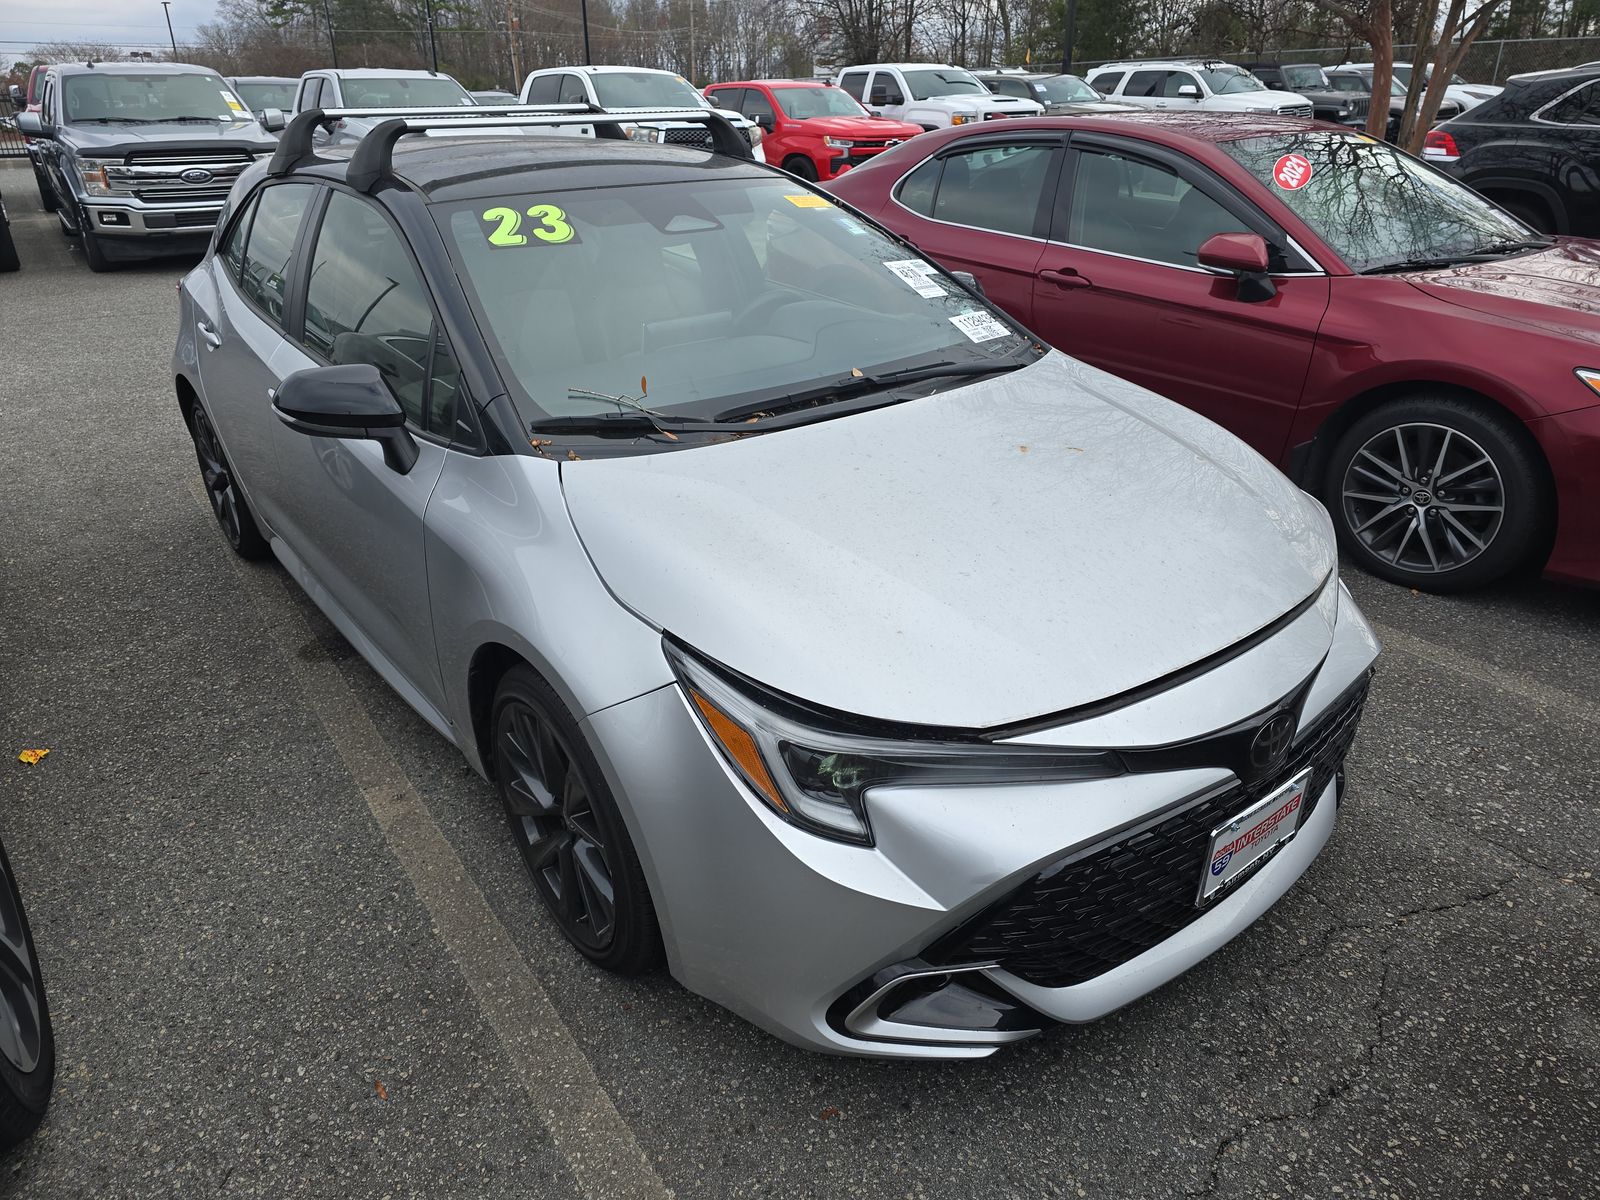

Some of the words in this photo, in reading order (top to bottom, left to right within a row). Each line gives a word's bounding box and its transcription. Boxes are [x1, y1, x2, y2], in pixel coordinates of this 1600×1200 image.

[1278, 155, 1308, 187] 2021
[482, 203, 575, 247] 23
[1236, 796, 1300, 851] INTERSTATE
[1251, 824, 1279, 849] TOYOTA
[1213, 854, 1231, 874] 59
